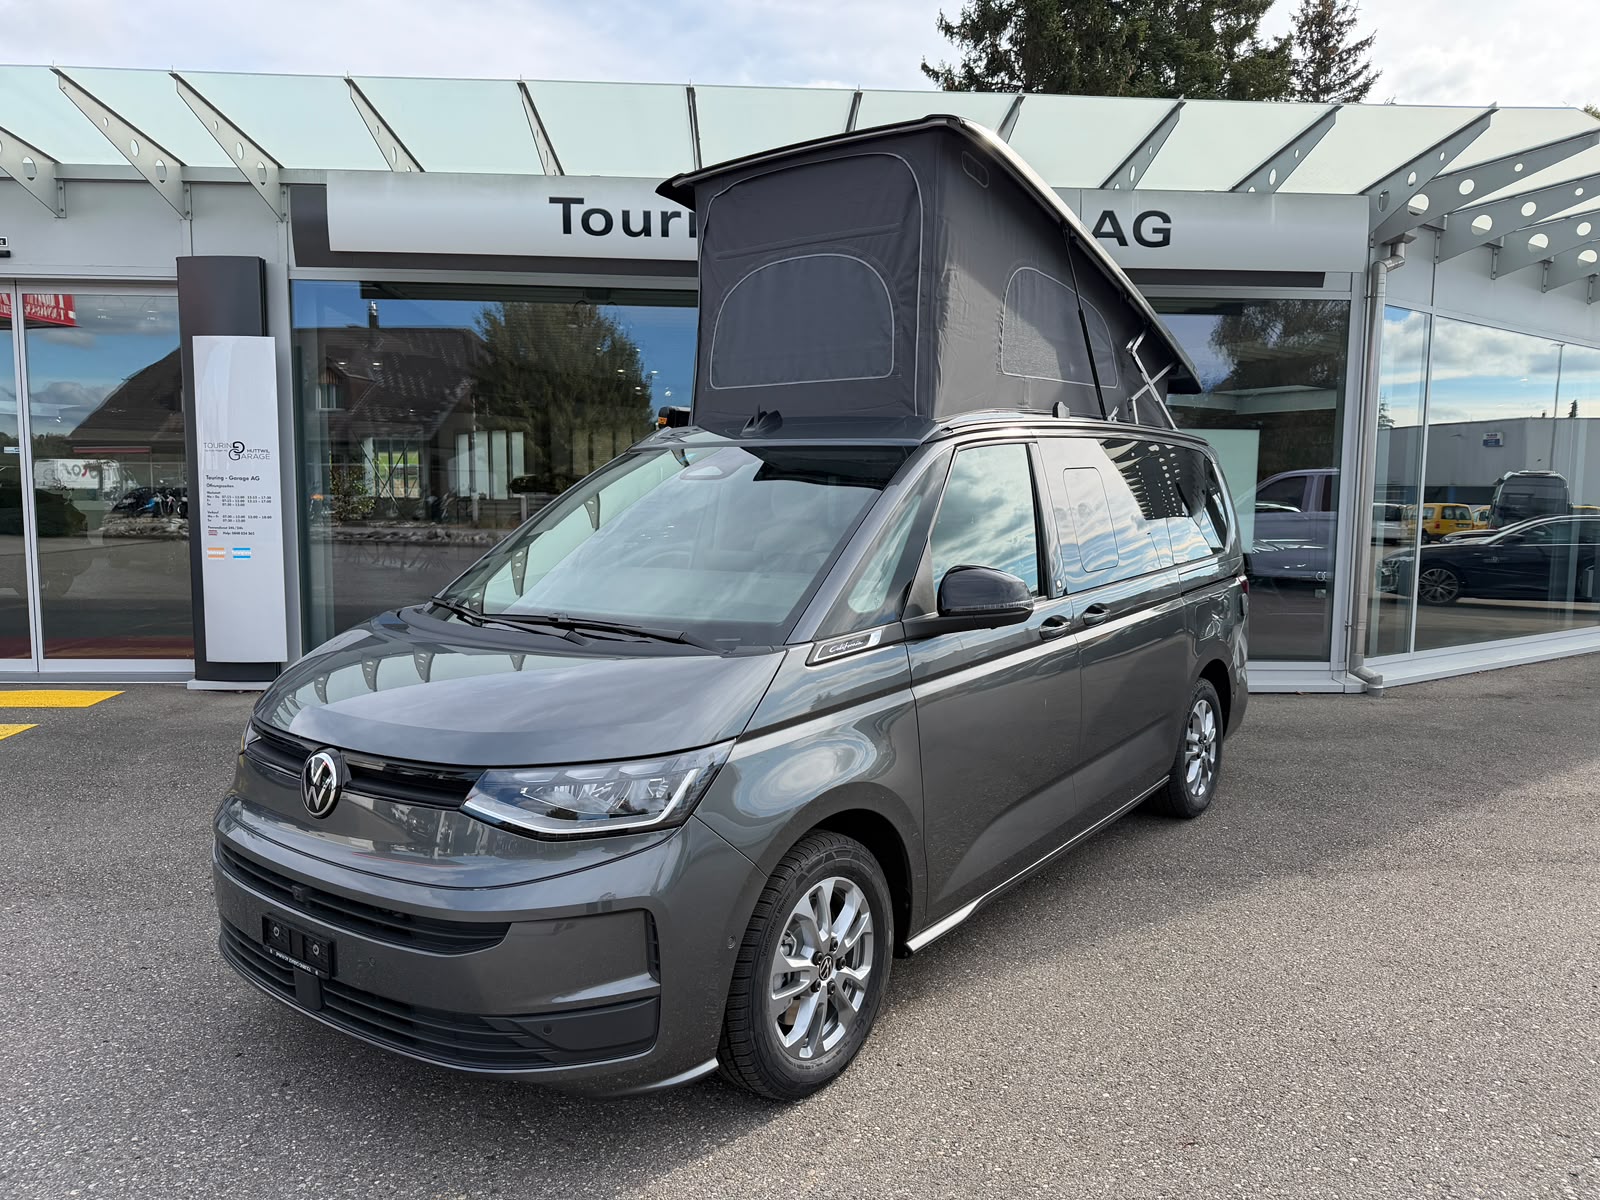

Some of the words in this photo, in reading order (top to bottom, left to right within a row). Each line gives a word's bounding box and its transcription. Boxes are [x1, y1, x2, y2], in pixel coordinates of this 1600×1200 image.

[548, 196, 697, 239] Touri
[1091, 210, 1172, 248] AG
[228, 448, 271, 461] GARAGE
[828, 640, 864, 653] California
